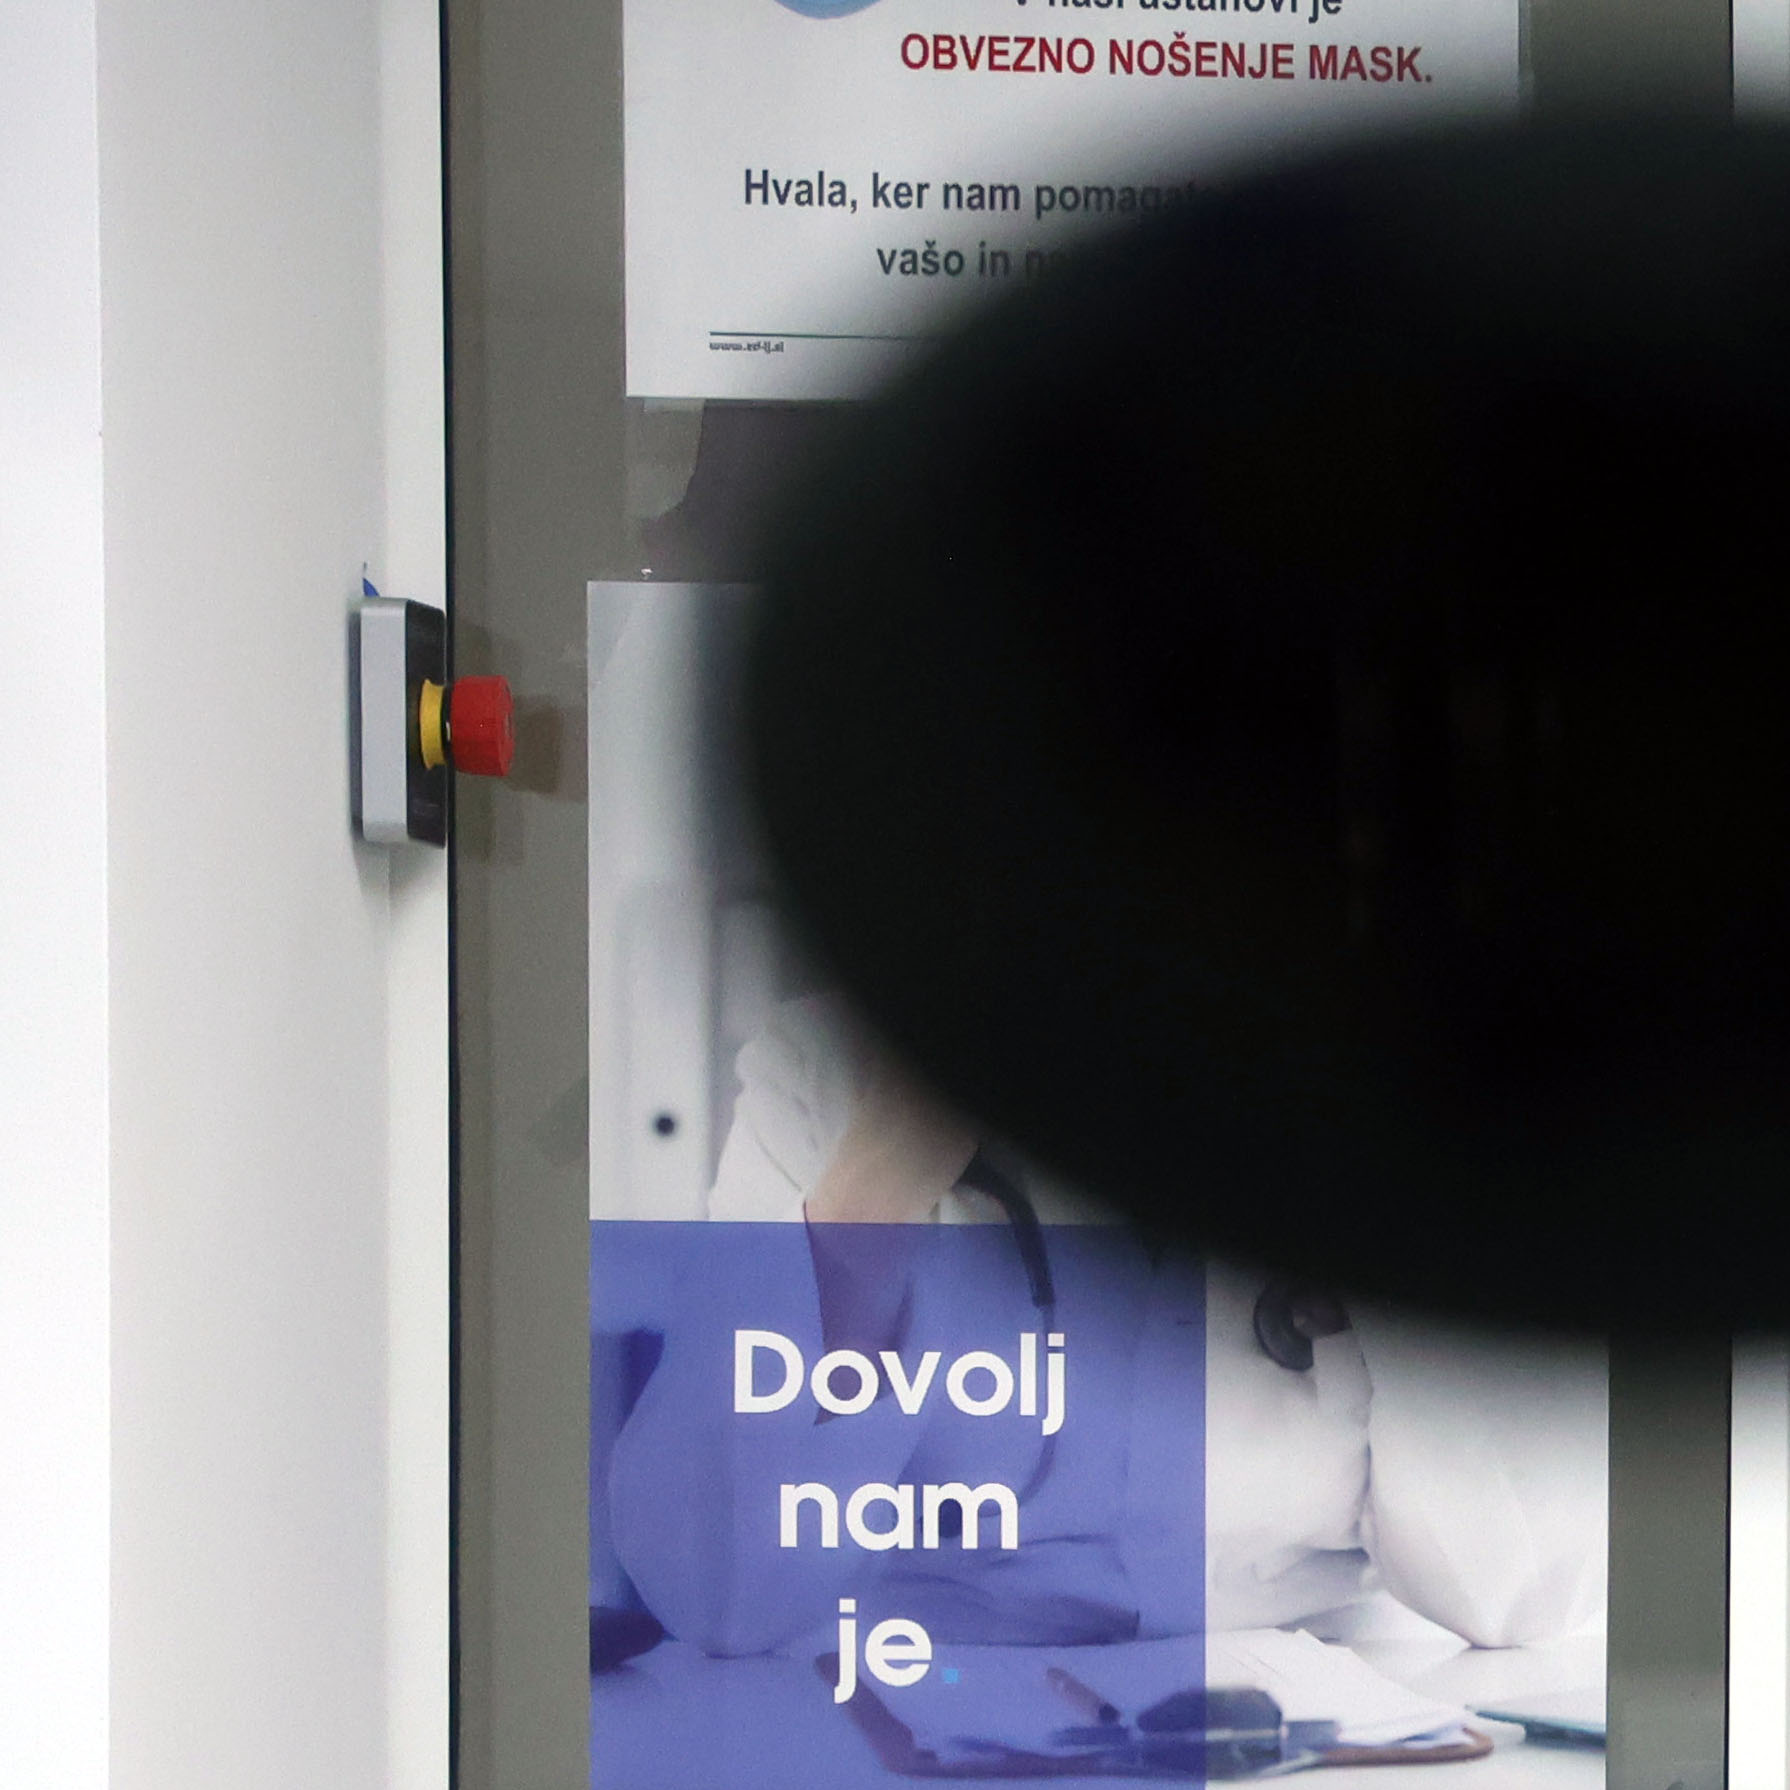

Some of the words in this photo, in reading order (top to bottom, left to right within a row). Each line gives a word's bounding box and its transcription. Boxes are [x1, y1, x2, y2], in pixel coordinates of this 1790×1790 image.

[900, 33, 1096, 74] OBVEZNO
[1108, 31, 1296, 80] NOŠENJE
[1308, 43, 1434, 83] MASK.
[743, 168, 859, 214] Hvala,
[871, 171, 930, 210] ker
[942, 182, 1021, 212] nam
[876, 239, 965, 277] vašo
[978, 241, 1010, 277] in
[734, 1329, 1065, 1436] Dovolj
[779, 1481, 1019, 1551] nam
